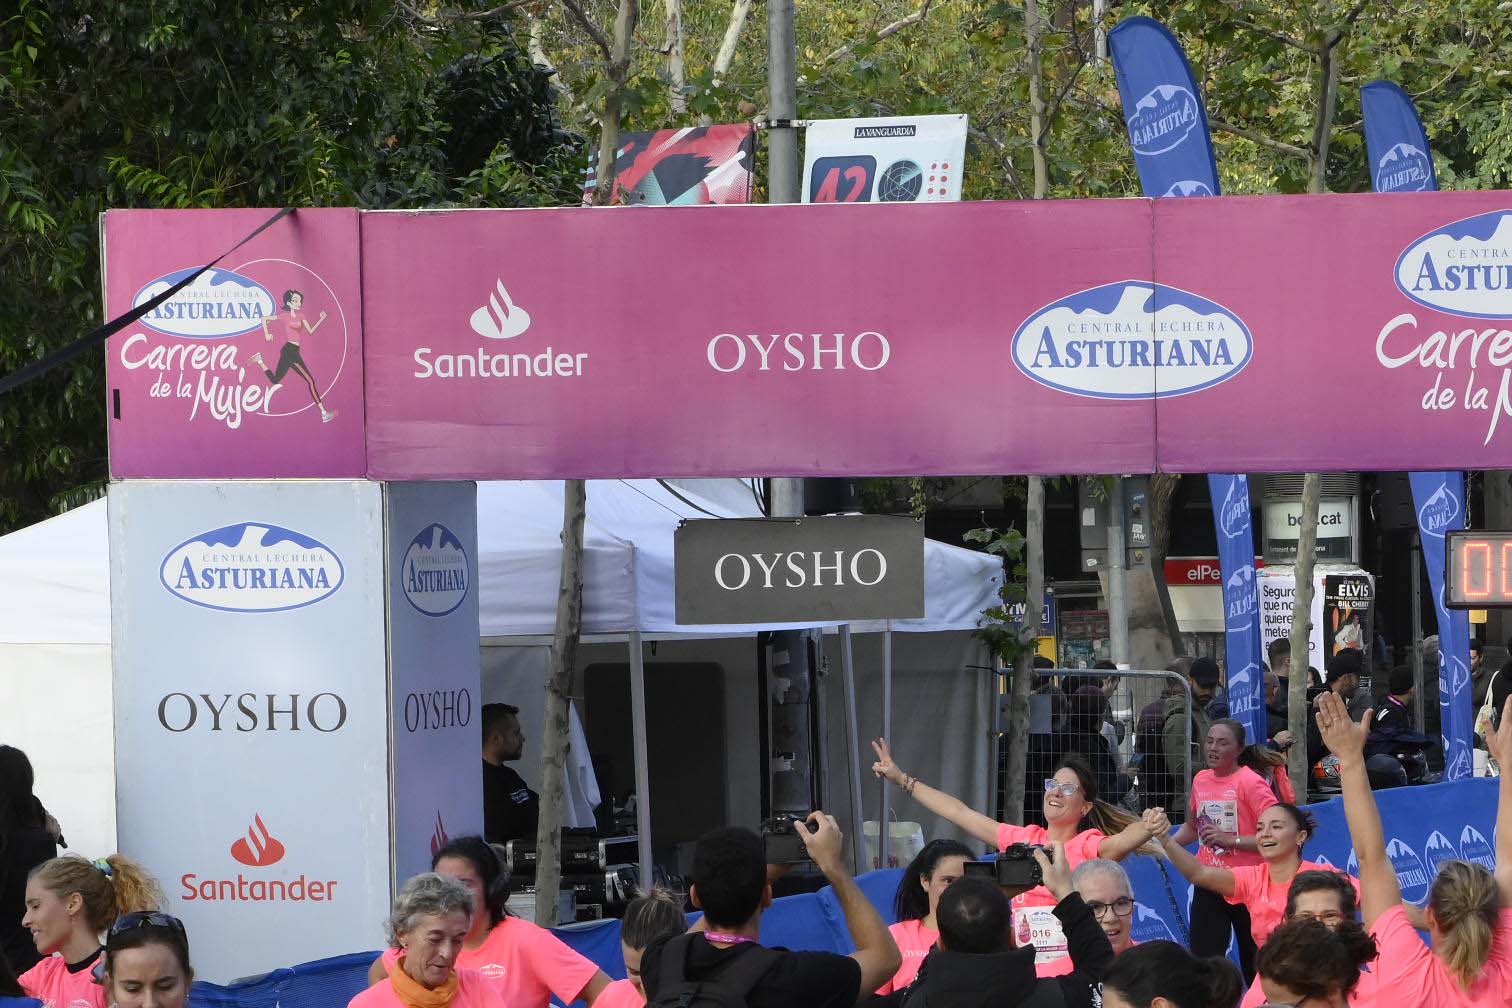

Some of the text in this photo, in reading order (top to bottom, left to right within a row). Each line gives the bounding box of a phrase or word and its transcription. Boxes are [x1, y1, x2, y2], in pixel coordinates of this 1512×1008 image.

[865, 127, 914, 137] VANGUARDIA
[1067, 320, 1225, 334] CENTRAL LECHERA
[120, 333, 239, 371] Carrera
[414, 347, 588, 379] Santander
[706, 331, 891, 372] OYSHO
[1030, 325, 1234, 369] ASTURIANA
[149, 367, 283, 429] de la Mujer
[1421, 372, 1456, 411] de
[1463, 370, 1489, 411] la
[174, 556, 332, 591] ASTURIANA
[202, 553, 325, 564] CENTRAL LECHERA
[715, 548, 887, 591] OYSHO
[407, 559, 465, 593] ASTURIANA
[1338, 585, 1369, 597] ELVIS
[1263, 602, 1281, 613] que
[157, 692, 347, 732] OYSHO
[404, 688, 471, 733] OYSHO
[181, 873, 337, 902] Santander
[1032, 929, 1051, 938] 016
